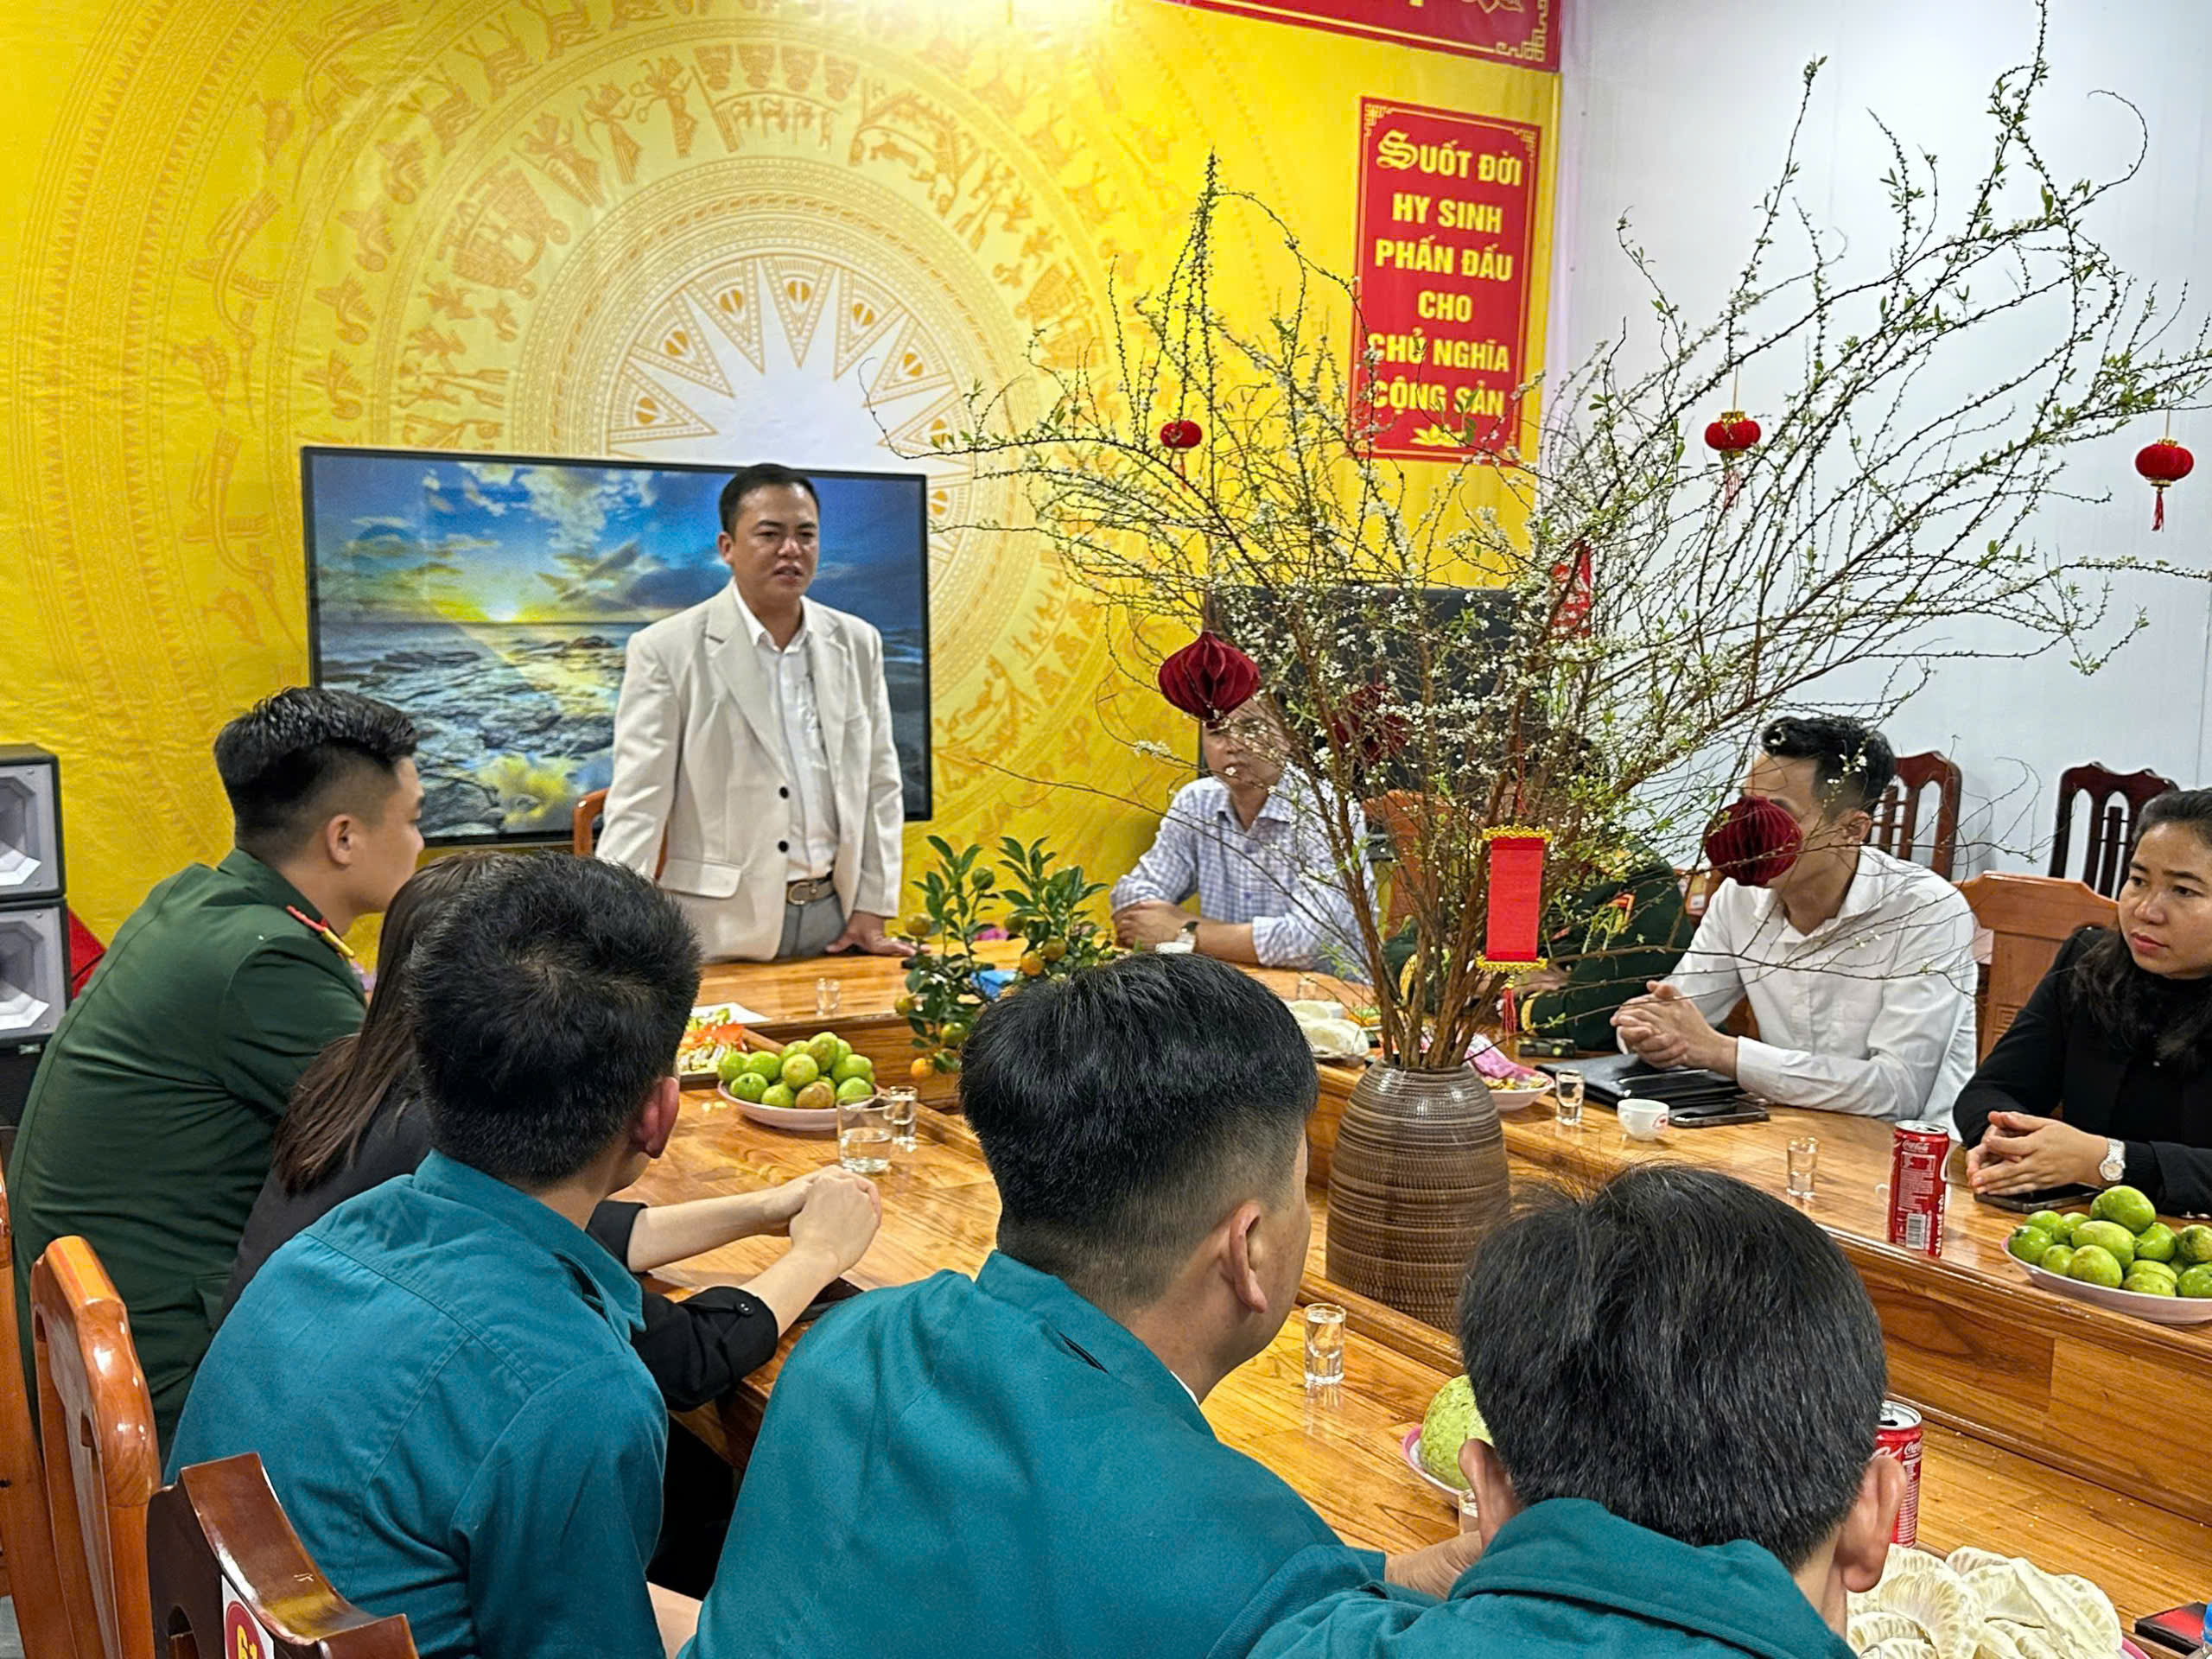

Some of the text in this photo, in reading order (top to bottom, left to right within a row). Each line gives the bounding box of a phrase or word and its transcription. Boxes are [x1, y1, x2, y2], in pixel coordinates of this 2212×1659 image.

[1376, 130, 1522, 187] SUỐT ĐỜI
[1392, 193, 1503, 233] HY SINH
[1375, 234, 1513, 282] PHẤN ĐẤU
[1418, 290, 1472, 323] CHO
[1367, 327, 1510, 372] CHỦ NGHĨA
[1372, 375, 1504, 416] CỘNG SẢN
